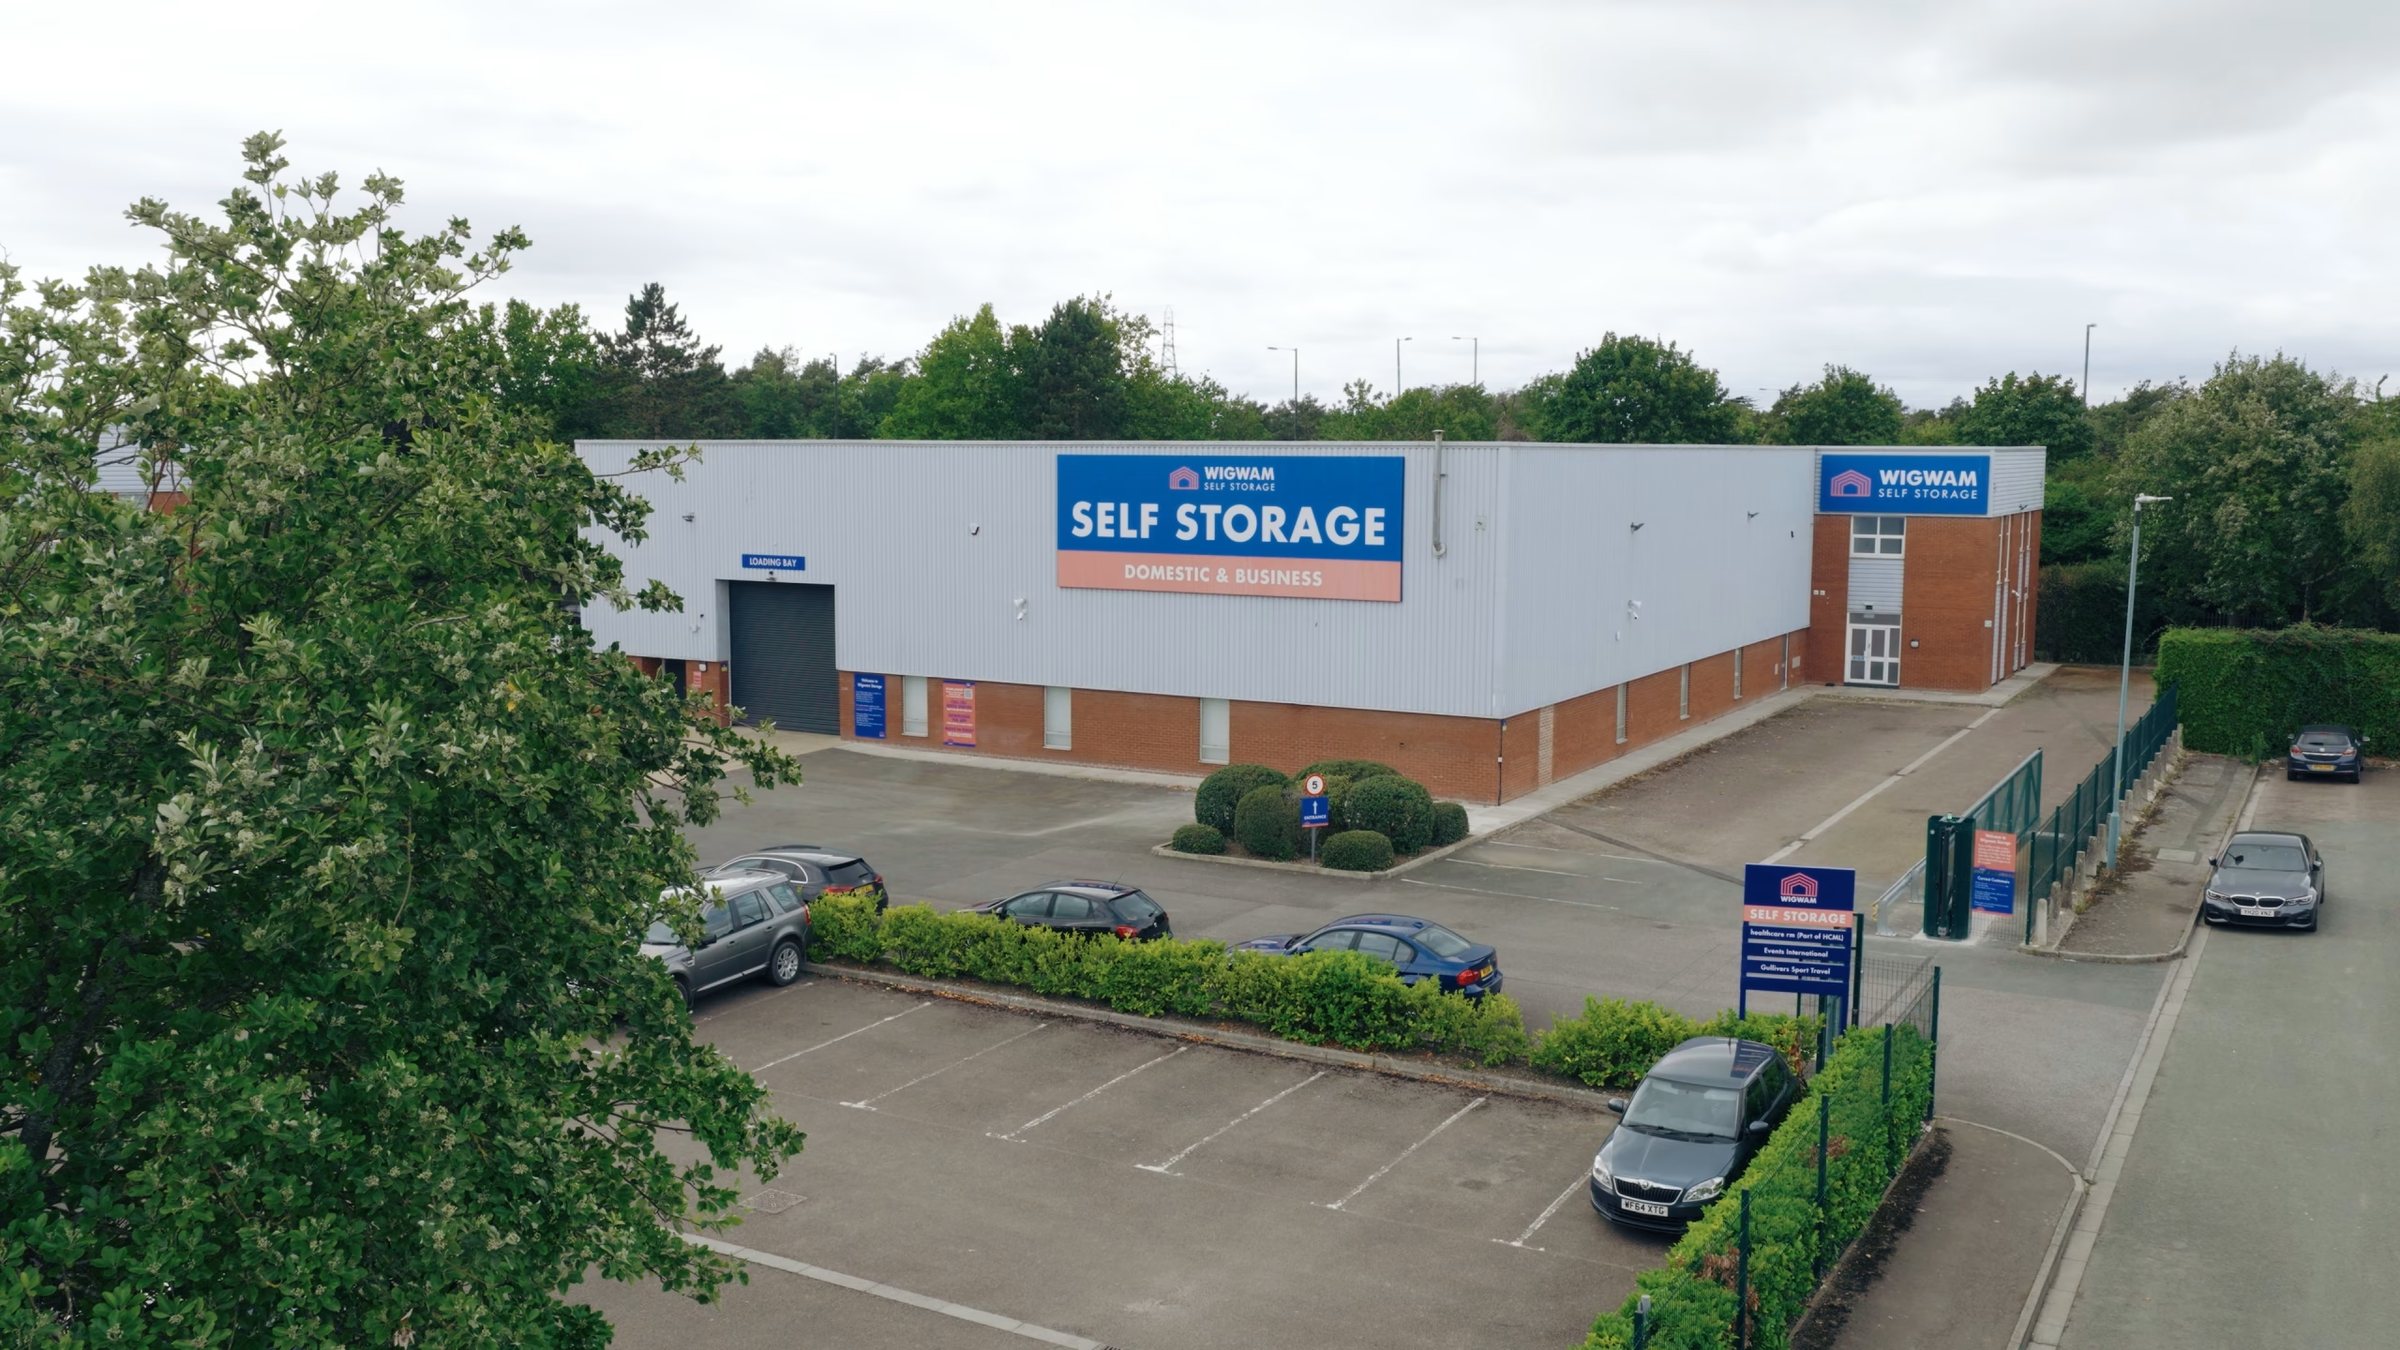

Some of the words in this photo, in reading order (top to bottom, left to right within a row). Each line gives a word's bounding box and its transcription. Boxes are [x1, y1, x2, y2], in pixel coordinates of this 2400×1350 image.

[1204, 466, 1275, 481] WIGWAM
[1879, 470, 1977, 487] WIGWAM
[1204, 482, 1226, 491] SELF
[1230, 482, 1276, 492] STORAGE
[1878, 488, 1908, 498] SELF
[1914, 488, 1978, 499] STORAGE
[1071, 501, 1160, 539] SELF
[1175, 503, 1386, 546] STORAGE
[749, 557, 781, 567] LOADING
[782, 558, 797, 567] BAY
[1125, 564, 1210, 583] DOMESTIC
[1216, 568, 1229, 583] &
[1235, 570, 1323, 587] BUSINESS
[1312, 780, 1318, 789] 5
[1780, 896, 1817, 904] WIGWAM
[1750, 909, 1779, 920] SELF
[1783, 910, 1847, 924] STORAGE
[1750, 928, 1785, 938] healthcare
[1797, 932, 1813, 940] (Part
[1814, 932, 1822, 940] of
[1764, 946, 1785, 955] Events
[1786, 947, 1829, 958] International
[1760, 964, 1790, 972] Gullivers
[1791, 965, 1809, 975] Sport
[1625, 1200, 1645, 1211] WF64
[1647, 1205, 1665, 1215] XTG
